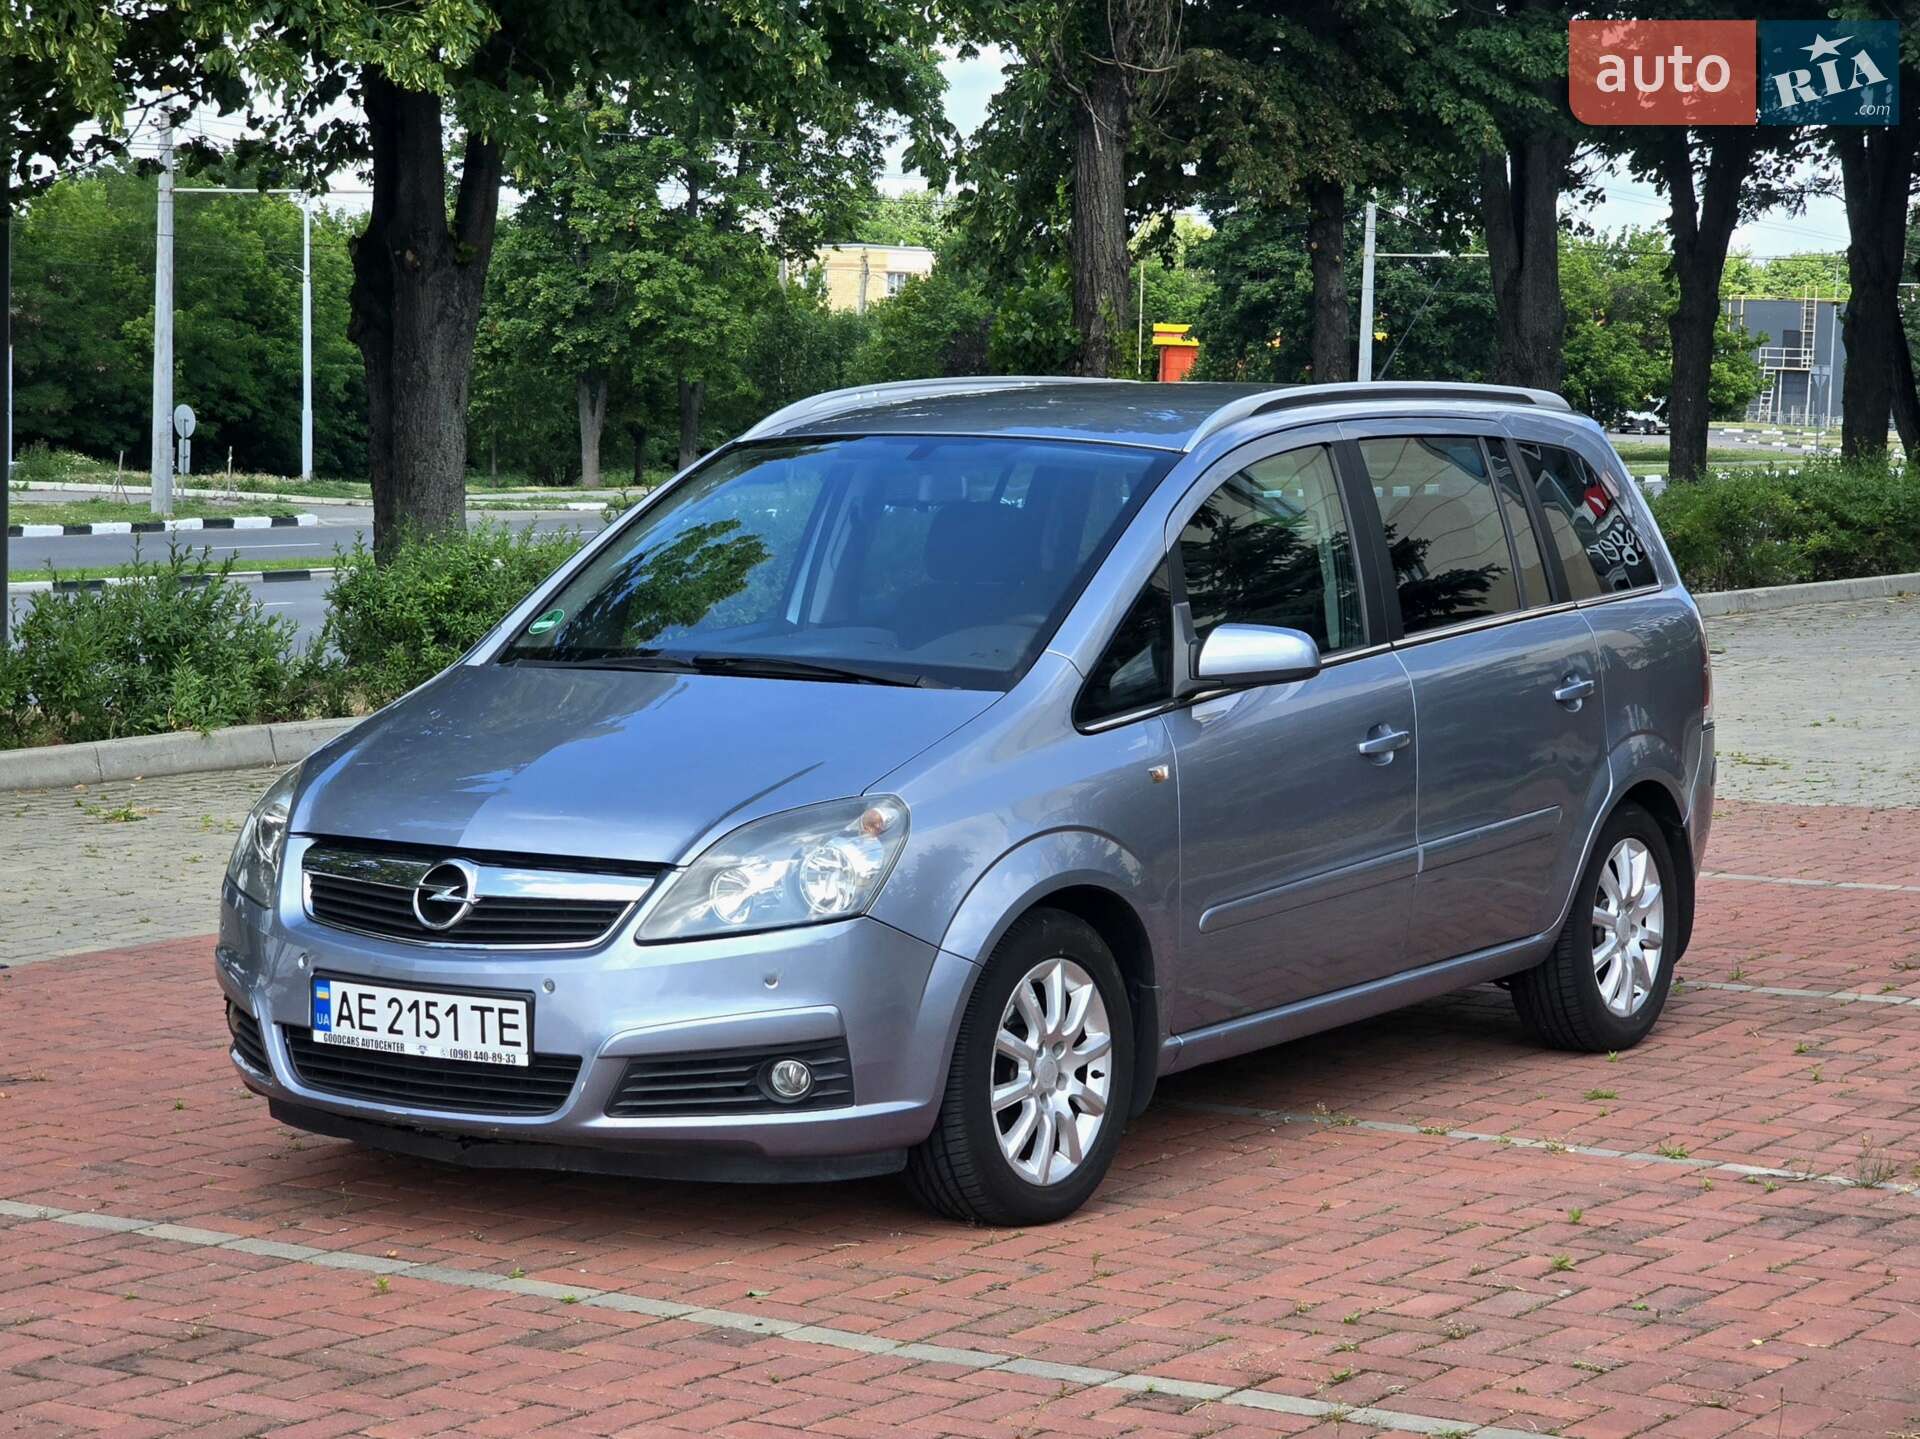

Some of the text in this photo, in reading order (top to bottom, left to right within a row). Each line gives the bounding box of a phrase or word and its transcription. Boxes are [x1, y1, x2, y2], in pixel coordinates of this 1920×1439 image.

[316, 1014, 330, 1026] UA
[335, 990, 522, 1047] AE 2151 TE
[323, 1033, 405, 1052] GOODCARS AUTOCENTER
[449, 1048, 517, 1064] (098) 440-89-33
